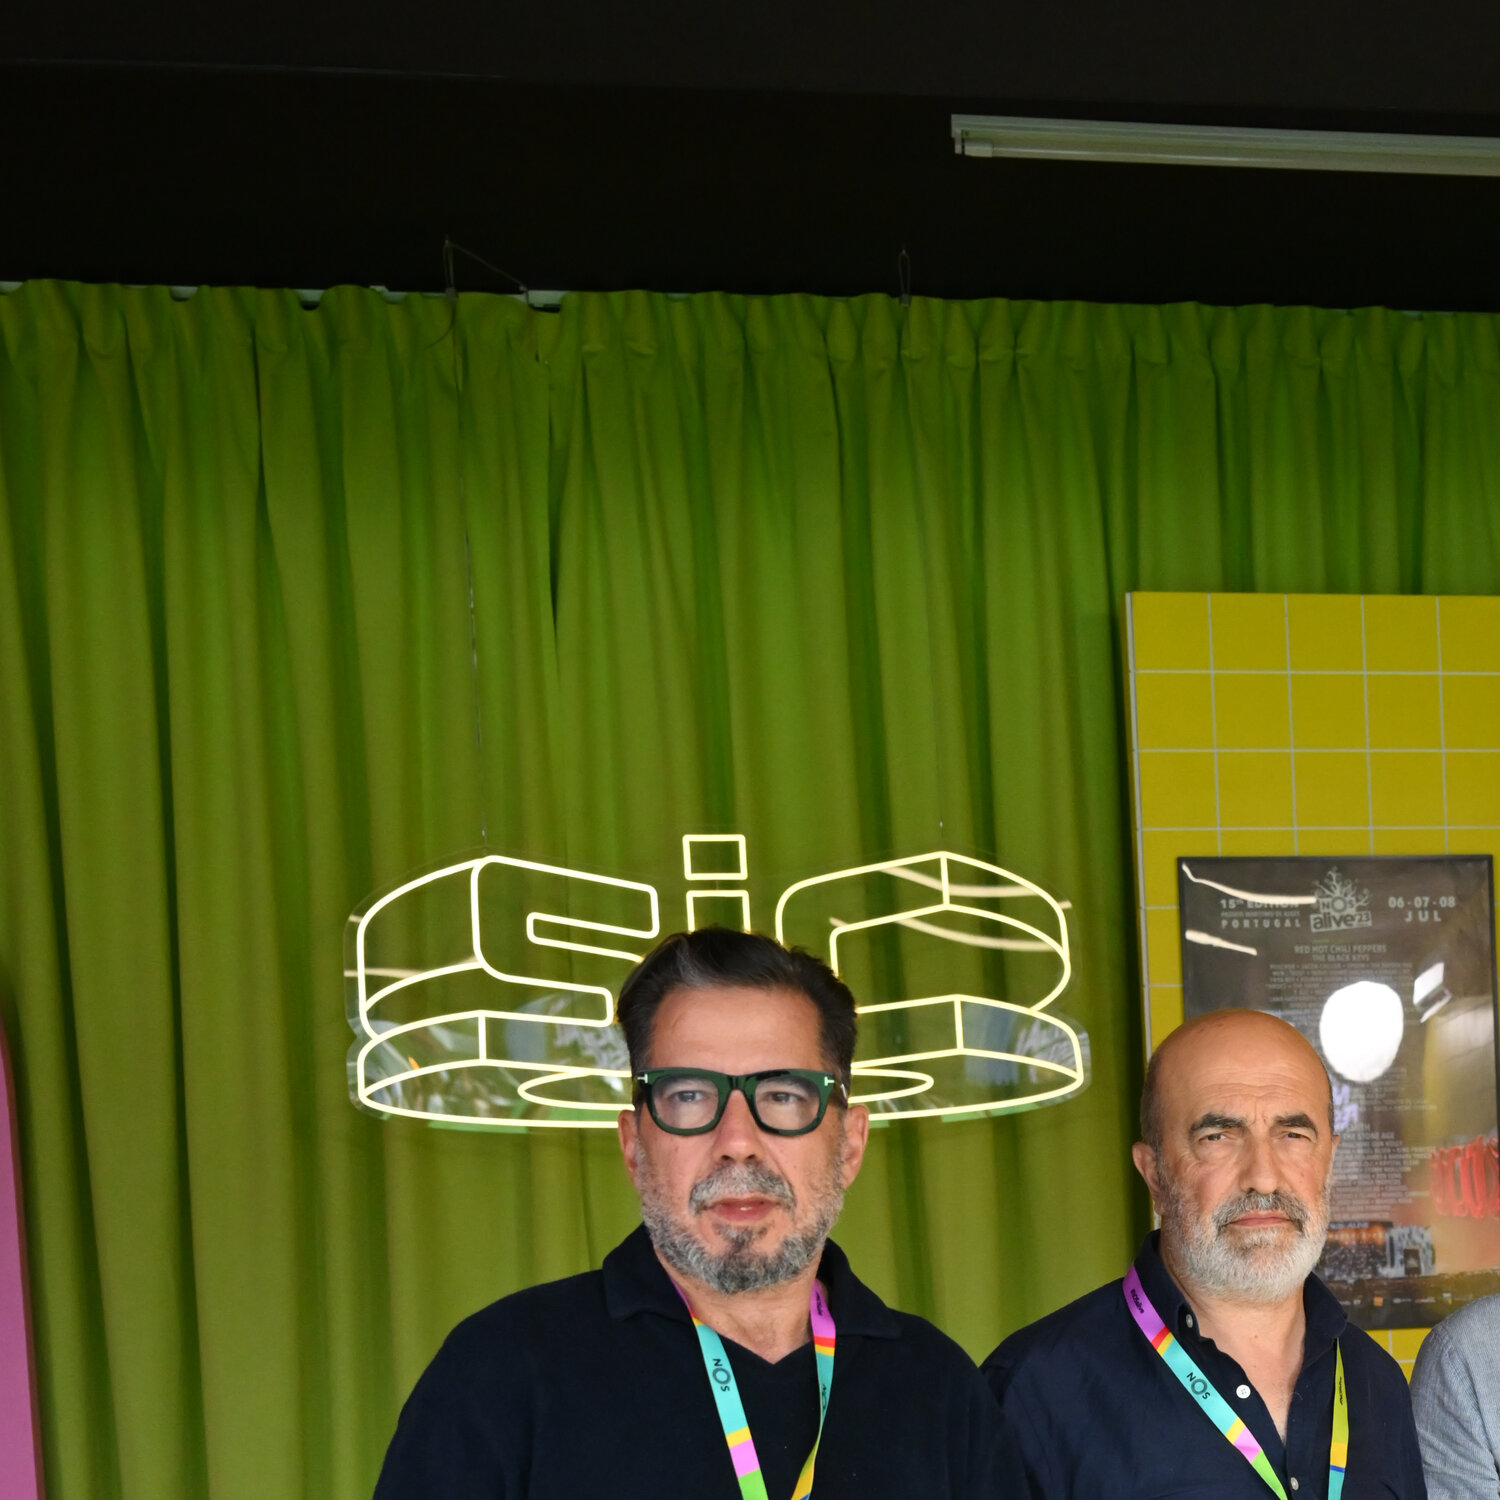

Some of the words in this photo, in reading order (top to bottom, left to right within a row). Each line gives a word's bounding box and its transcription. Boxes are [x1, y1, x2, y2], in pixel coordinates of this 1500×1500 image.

[1319, 895, 1358, 913] NOS
[1403, 909, 1442, 923] JUL
[1220, 918, 1301, 929] PORTUGAL
[1294, 944, 1310, 954] RED
[1312, 944, 1328, 954] HOT
[1330, 944, 1351, 954] CHILI
[1353, 944, 1387, 954] PEPPERS
[1312, 953, 1326, 962] THE
[1327, 953, 1350, 962] BLACK
[1352, 953, 1370, 962] KEYS
[712, 1358, 731, 1392] NOS
[1186, 1372, 1211, 1400] NOS
